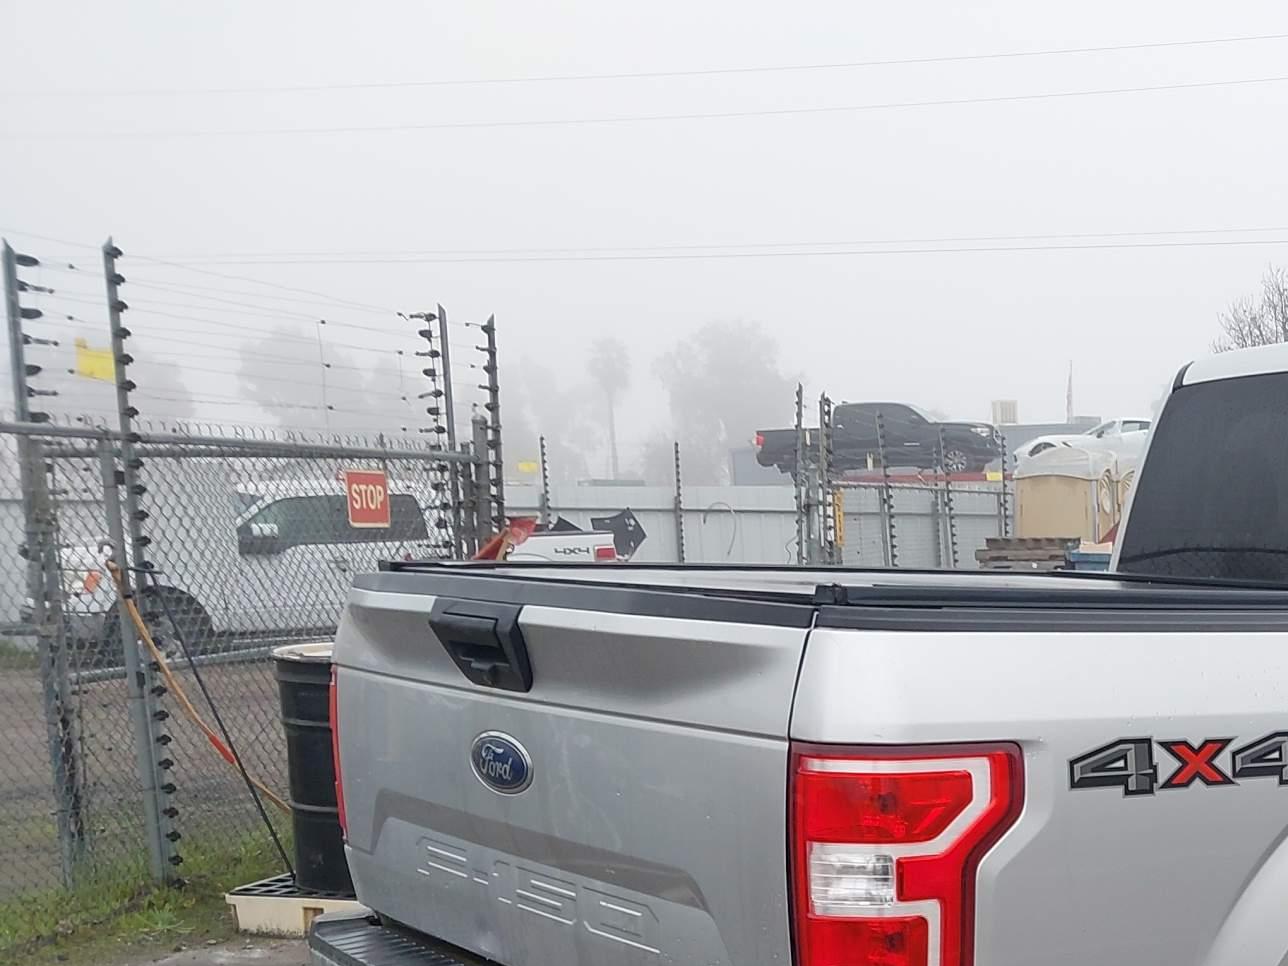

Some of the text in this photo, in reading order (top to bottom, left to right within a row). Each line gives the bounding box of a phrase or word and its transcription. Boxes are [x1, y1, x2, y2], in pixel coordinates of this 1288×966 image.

[351, 484, 385, 510] STOP
[480, 743, 513, 781] Ford
[415, 835, 661, 954] F-150
